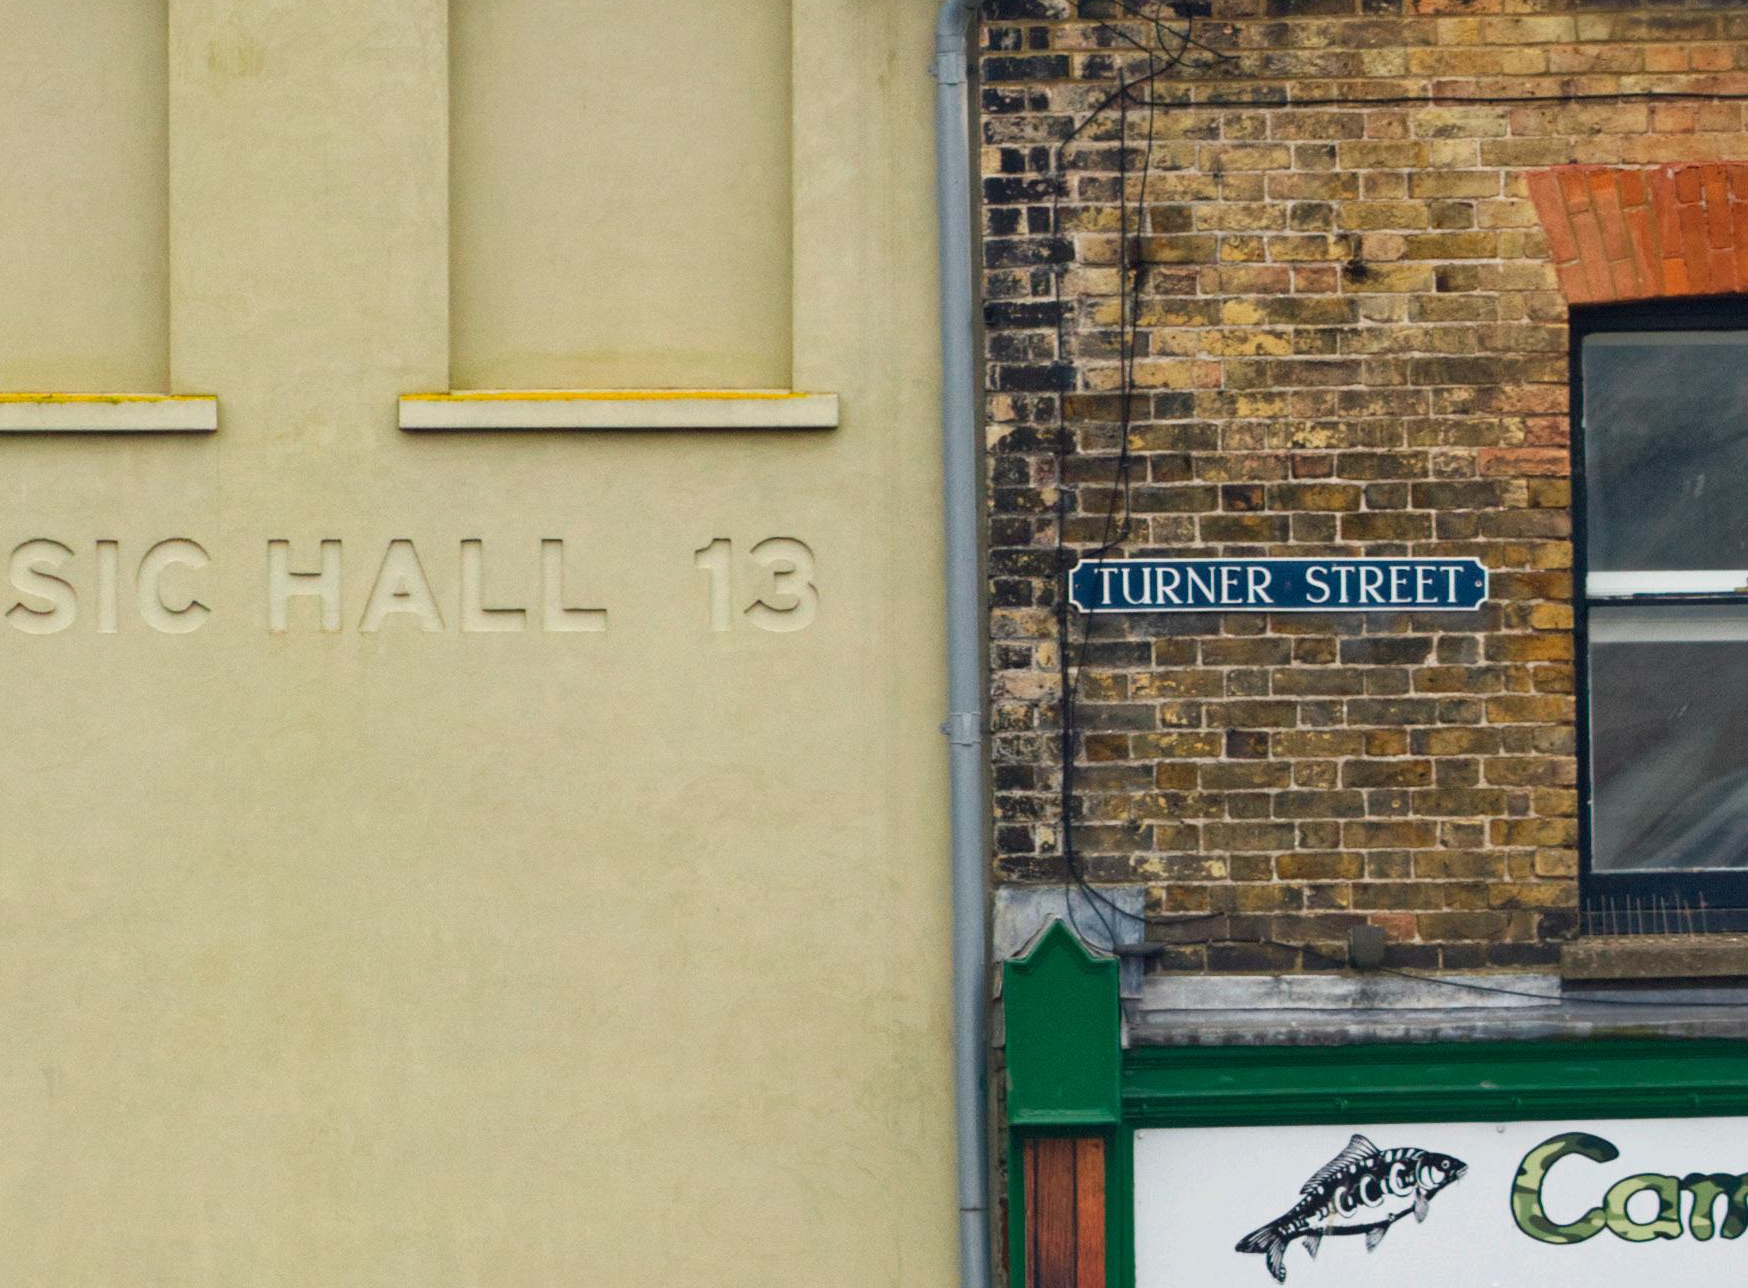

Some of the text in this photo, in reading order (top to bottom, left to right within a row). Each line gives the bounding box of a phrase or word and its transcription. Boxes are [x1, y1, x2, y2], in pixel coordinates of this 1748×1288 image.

[267, 538, 608, 633] HALL
[694, 536, 820, 633] 13
[1094, 565, 1464, 605] TURNER STREET
